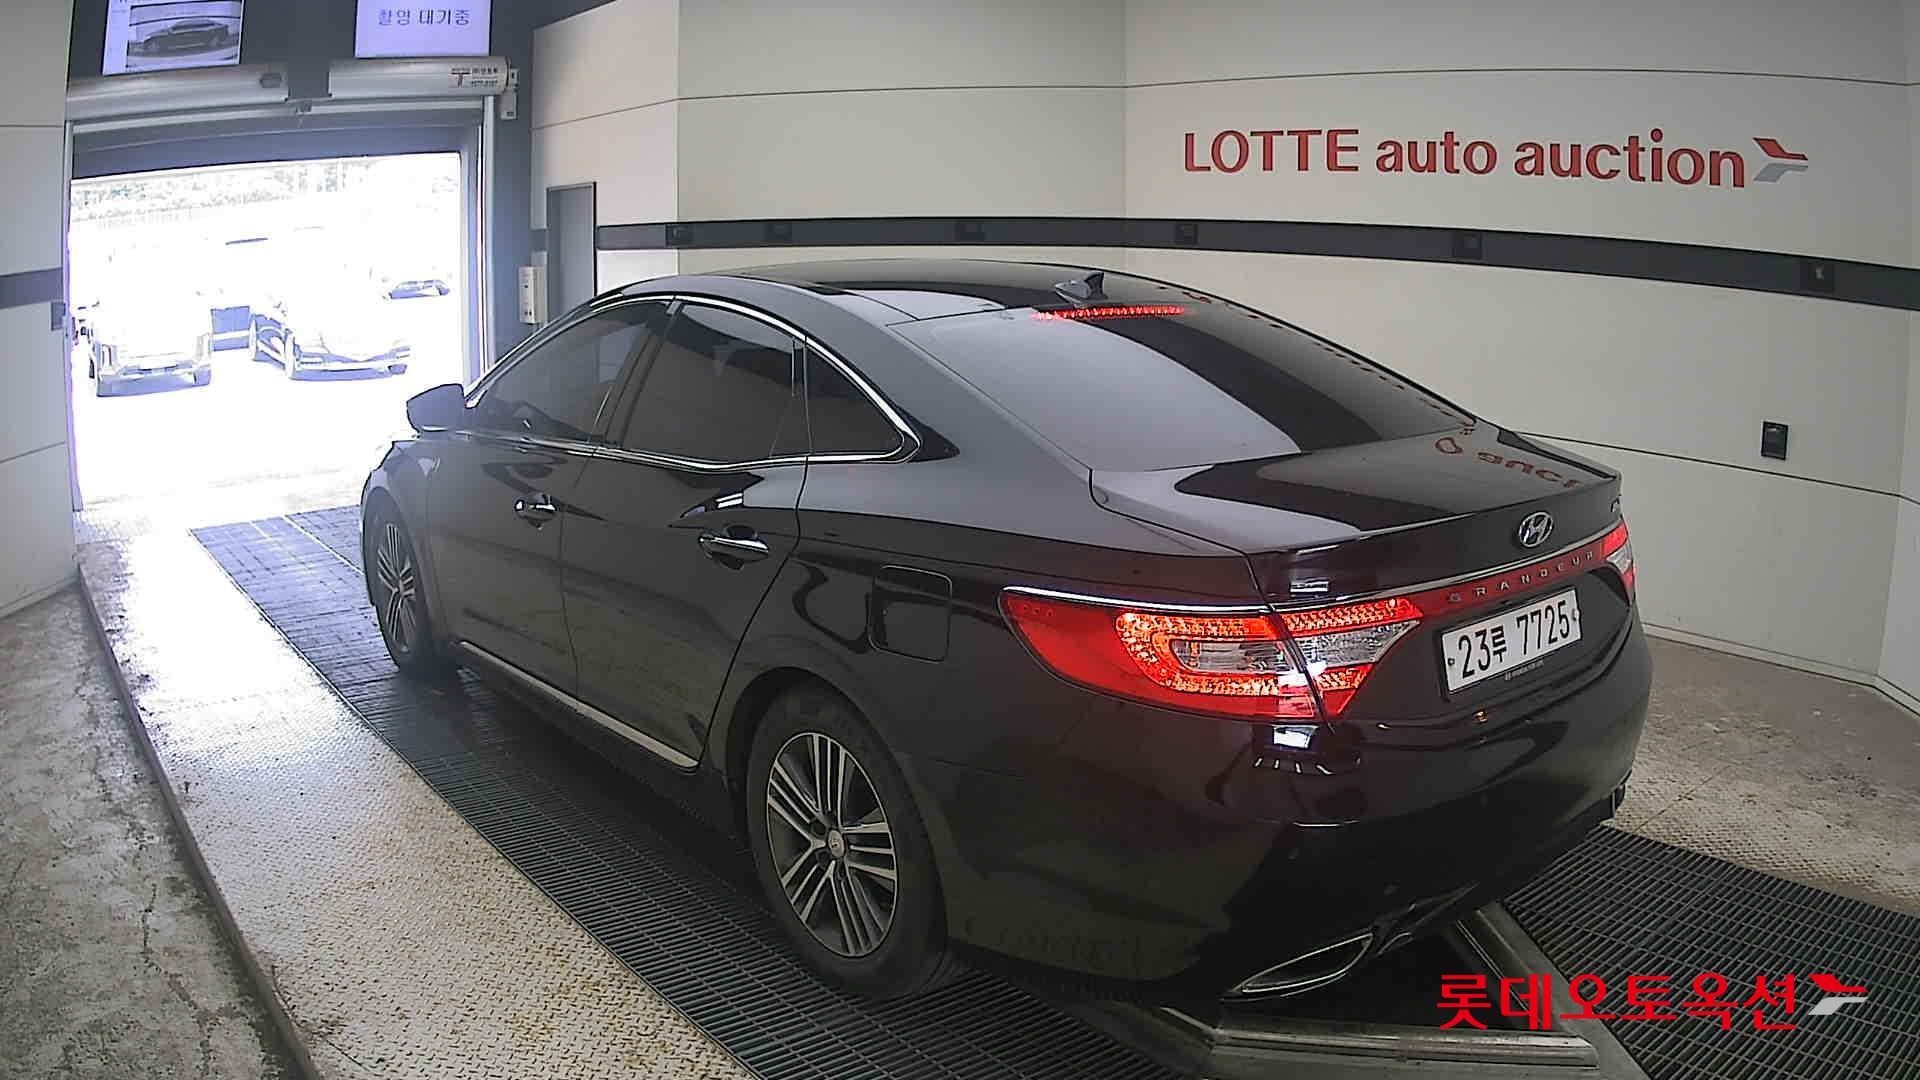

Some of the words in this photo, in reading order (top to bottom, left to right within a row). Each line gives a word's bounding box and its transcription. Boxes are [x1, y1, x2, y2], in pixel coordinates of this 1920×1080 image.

[419, 9, 470, 25] 대기중
[1184, 129, 1359, 173] LOTTE
[1376, 131, 1497, 175] auto
[1514, 128, 1745, 188] auction
[1448, 551, 1594, 602] GRANDEUR
[1458, 625, 1507, 679] 23루
[1516, 600, 1570, 656] 7725
